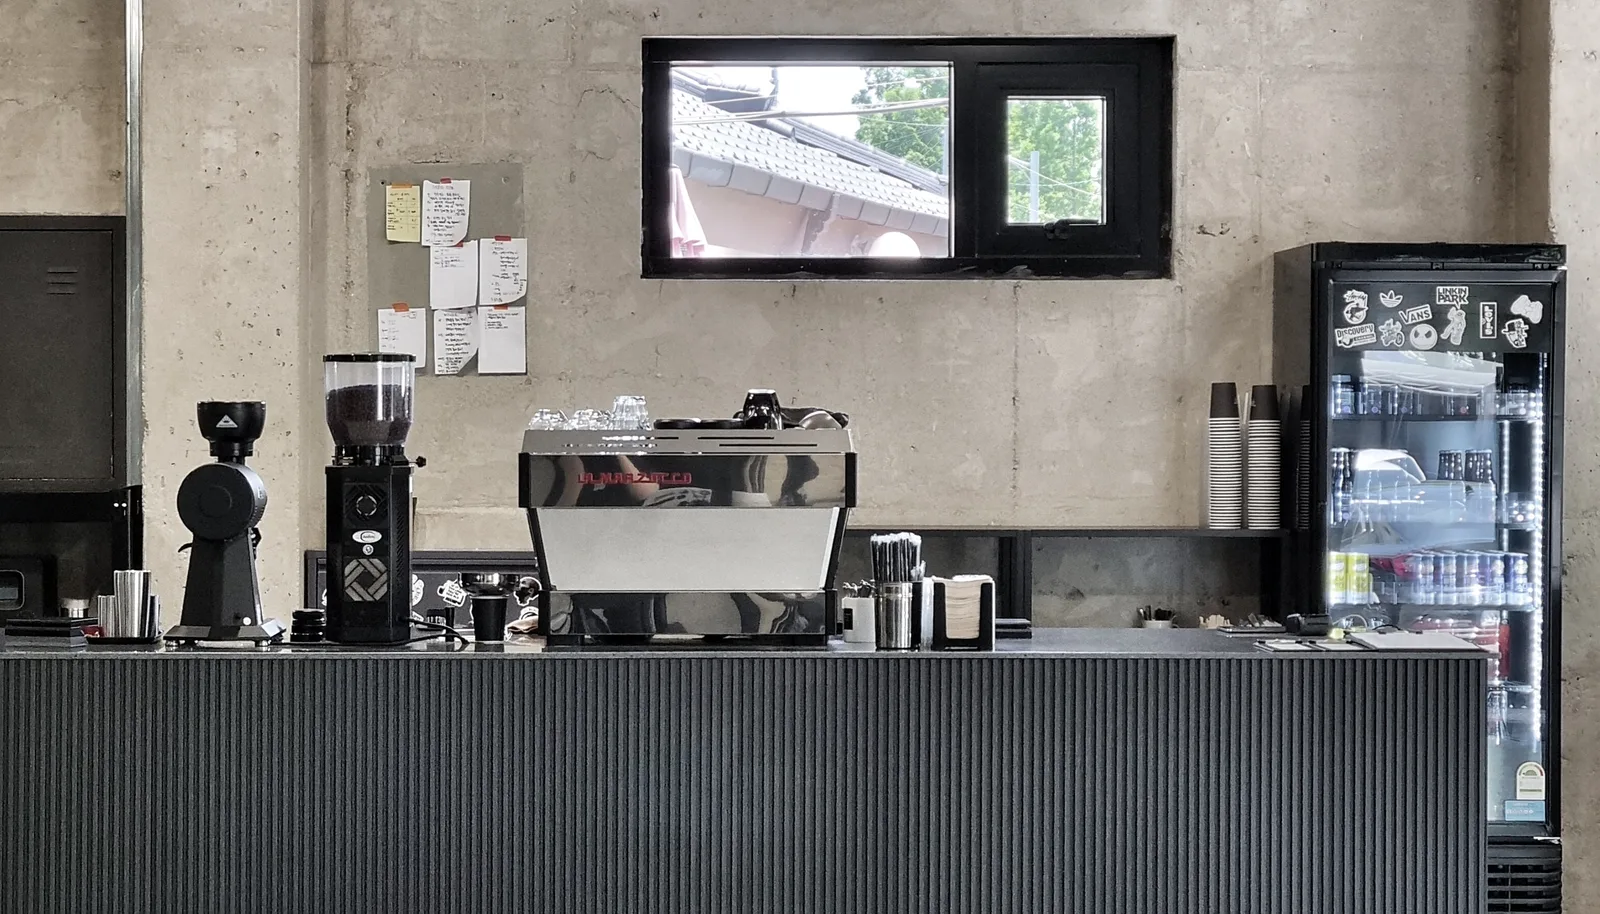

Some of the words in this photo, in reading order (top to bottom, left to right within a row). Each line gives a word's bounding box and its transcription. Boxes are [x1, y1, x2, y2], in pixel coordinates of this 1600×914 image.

[1438, 287, 1468, 295] LINKIN
[1437, 295, 1467, 303] PARK
[1400, 305, 1431, 323] VANS
